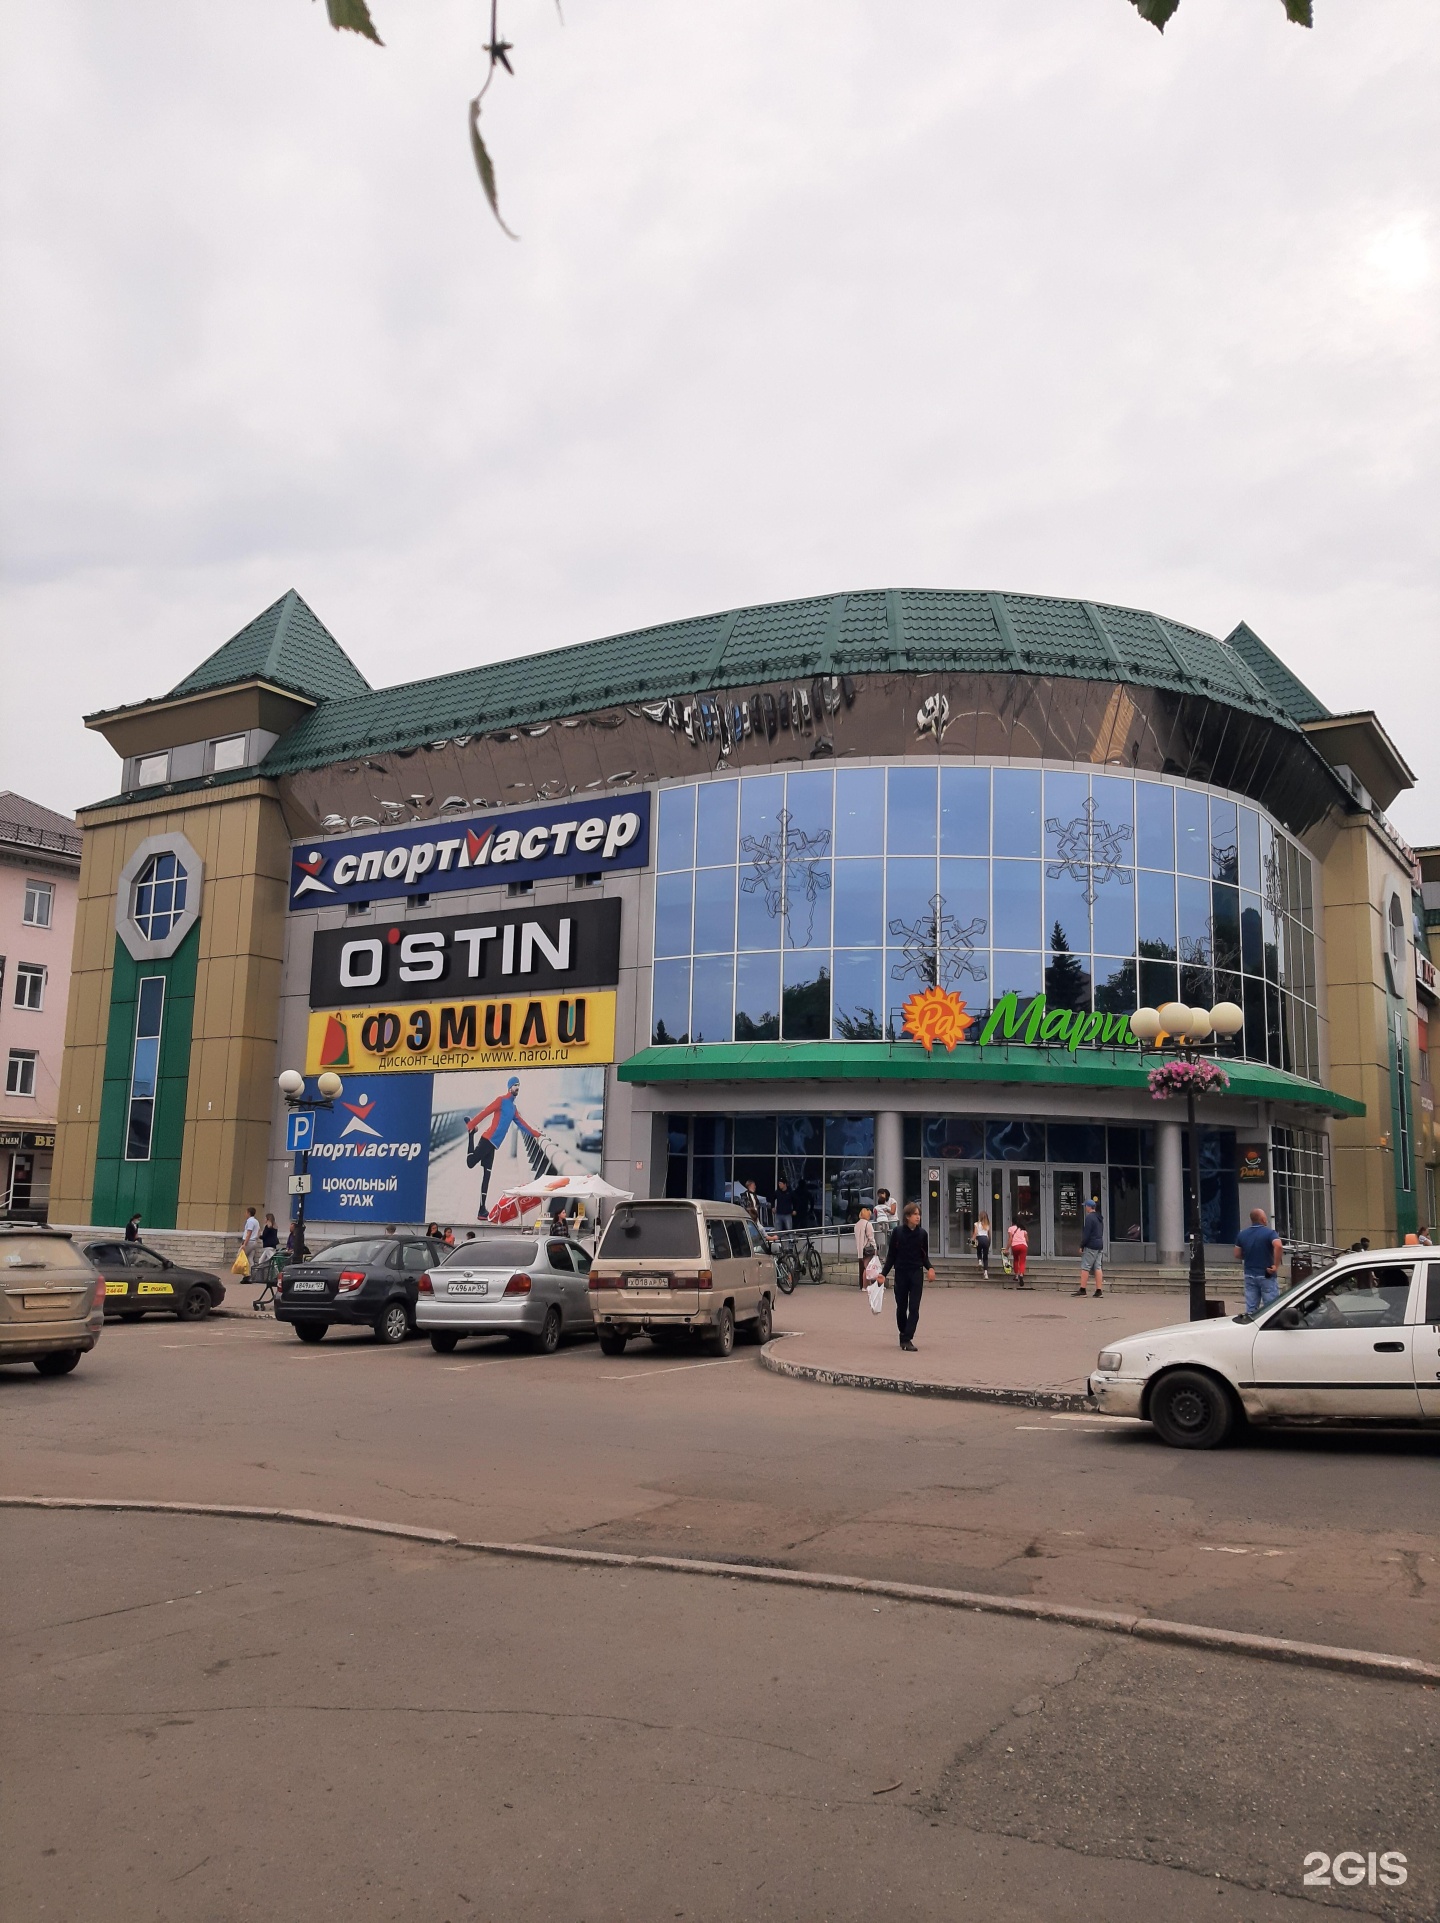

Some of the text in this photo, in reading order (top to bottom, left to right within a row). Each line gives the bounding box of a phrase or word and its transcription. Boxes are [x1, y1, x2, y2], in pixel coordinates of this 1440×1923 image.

[339, 918, 571, 988] O'STIN
[294, 1116, 310, 1147] P
[302, 1142, 421, 1161] портмастер
[322, 1175, 397, 1193] ЦОКОЛЬНЫЙ
[340, 1194, 374, 1207] ЭТАЖ
